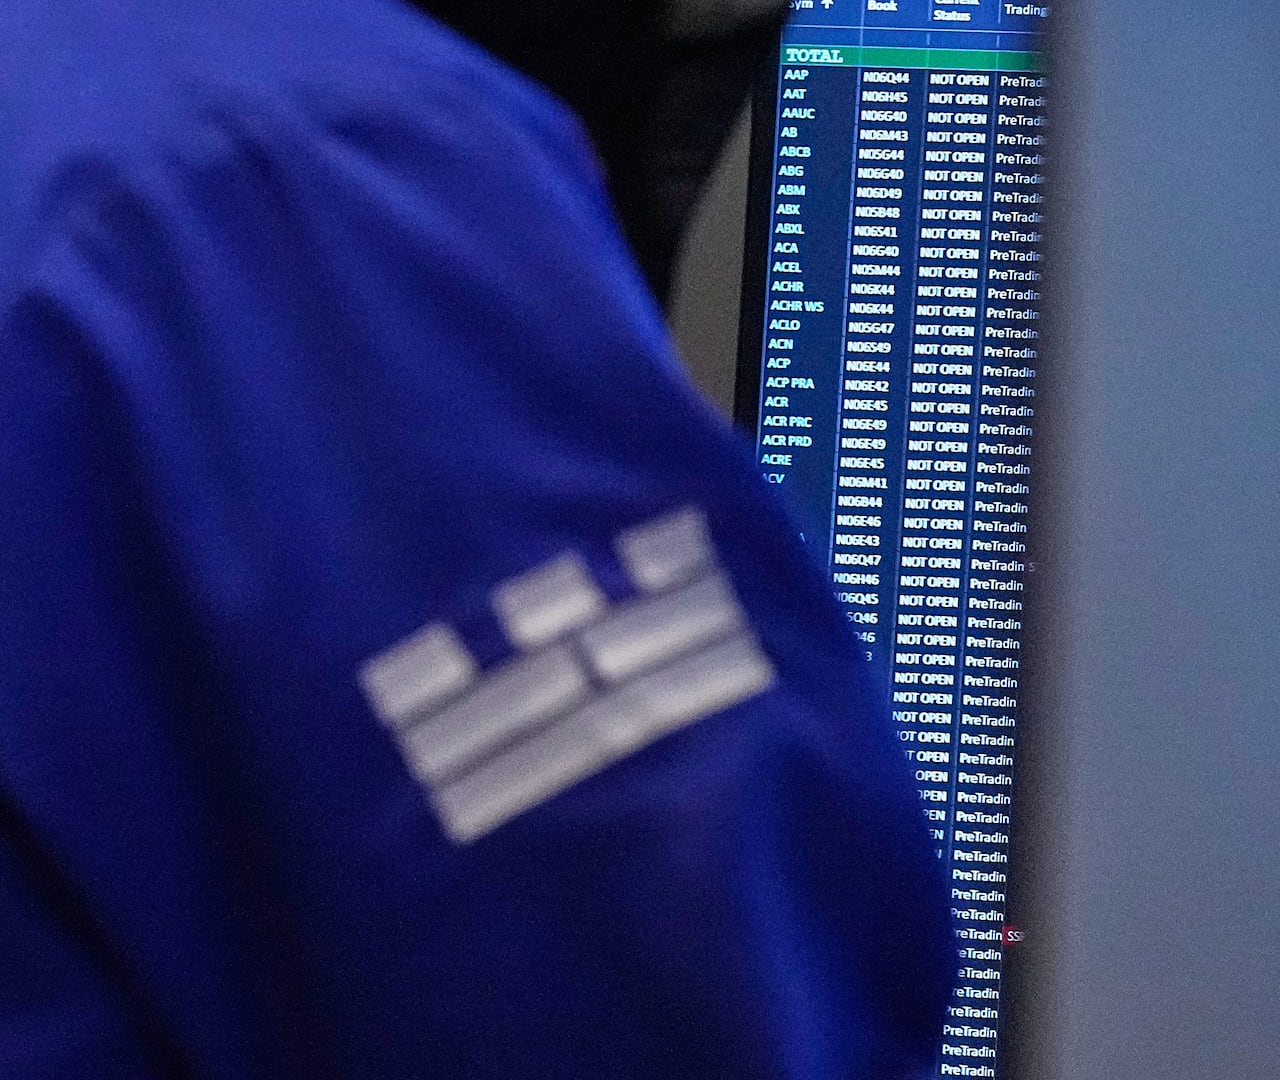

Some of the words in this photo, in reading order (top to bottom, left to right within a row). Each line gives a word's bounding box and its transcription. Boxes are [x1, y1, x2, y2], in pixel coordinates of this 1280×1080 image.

[867, 0, 898, 12] Book
[933, 9, 971, 22] Status
[786, 48, 843, 63] TOTAL
[784, 70, 809, 80] AAP
[930, 74, 956, 84] NOT
[956, 75, 989, 86] OPEN
[783, 89, 807, 99] AAT
[929, 93, 955, 104] NOT
[955, 94, 988, 105] OPEN
[782, 108, 815, 119] AAUC
[928, 112, 954, 123] NOT
[954, 113, 987, 124] OPEN
[781, 127, 798, 137] AB
[927, 132, 952, 142] NOT
[953, 132, 986, 143] OPEN
[780, 146, 811, 157] ABCB
[926, 151, 951, 162] NOT
[952, 152, 985, 163] OPEN
[778, 165, 804, 176] ABG
[925, 170, 950, 181] NOT
[951, 171, 984, 182] OPEN
[777, 185, 805, 195] ABM
[776, 204, 800, 214] ABX
[775, 223, 805, 234] ABXL
[774, 242, 798, 253] ACA
[773, 262, 802, 273] ACEL
[771, 281, 804, 292] ACHR
[770, 300, 802, 311] ACHR
[804, 301, 824, 312] WS
[916, 305, 942, 316] NOT
[943, 306, 976, 317] OPEN
[769, 319, 800, 330] ACLO
[915, 324, 941, 335] NOT
[942, 325, 974, 336] OPEN
[768, 339, 793, 349] ACN
[767, 358, 791, 368] ACP
[766, 377, 790, 388] ACP
[791, 378, 815, 389] PRA
[765, 396, 788, 407] ACR
[763, 416, 787, 426] ACR
[789, 416, 812, 427] PRC
[762, 435, 786, 446] ACR
[788, 436, 812, 447] PRD
[761, 454, 792, 465] ACRE
[907, 460, 933, 470] NOT
[934, 461, 966, 472] OPEN
[906, 479, 932, 490] NOT
[933, 480, 965, 491] OPEN
[897, 634, 923, 644] NOT
[924, 635, 956, 646] OPEN
[896, 653, 922, 664] NOT
[923, 654, 955, 665] OPEN
